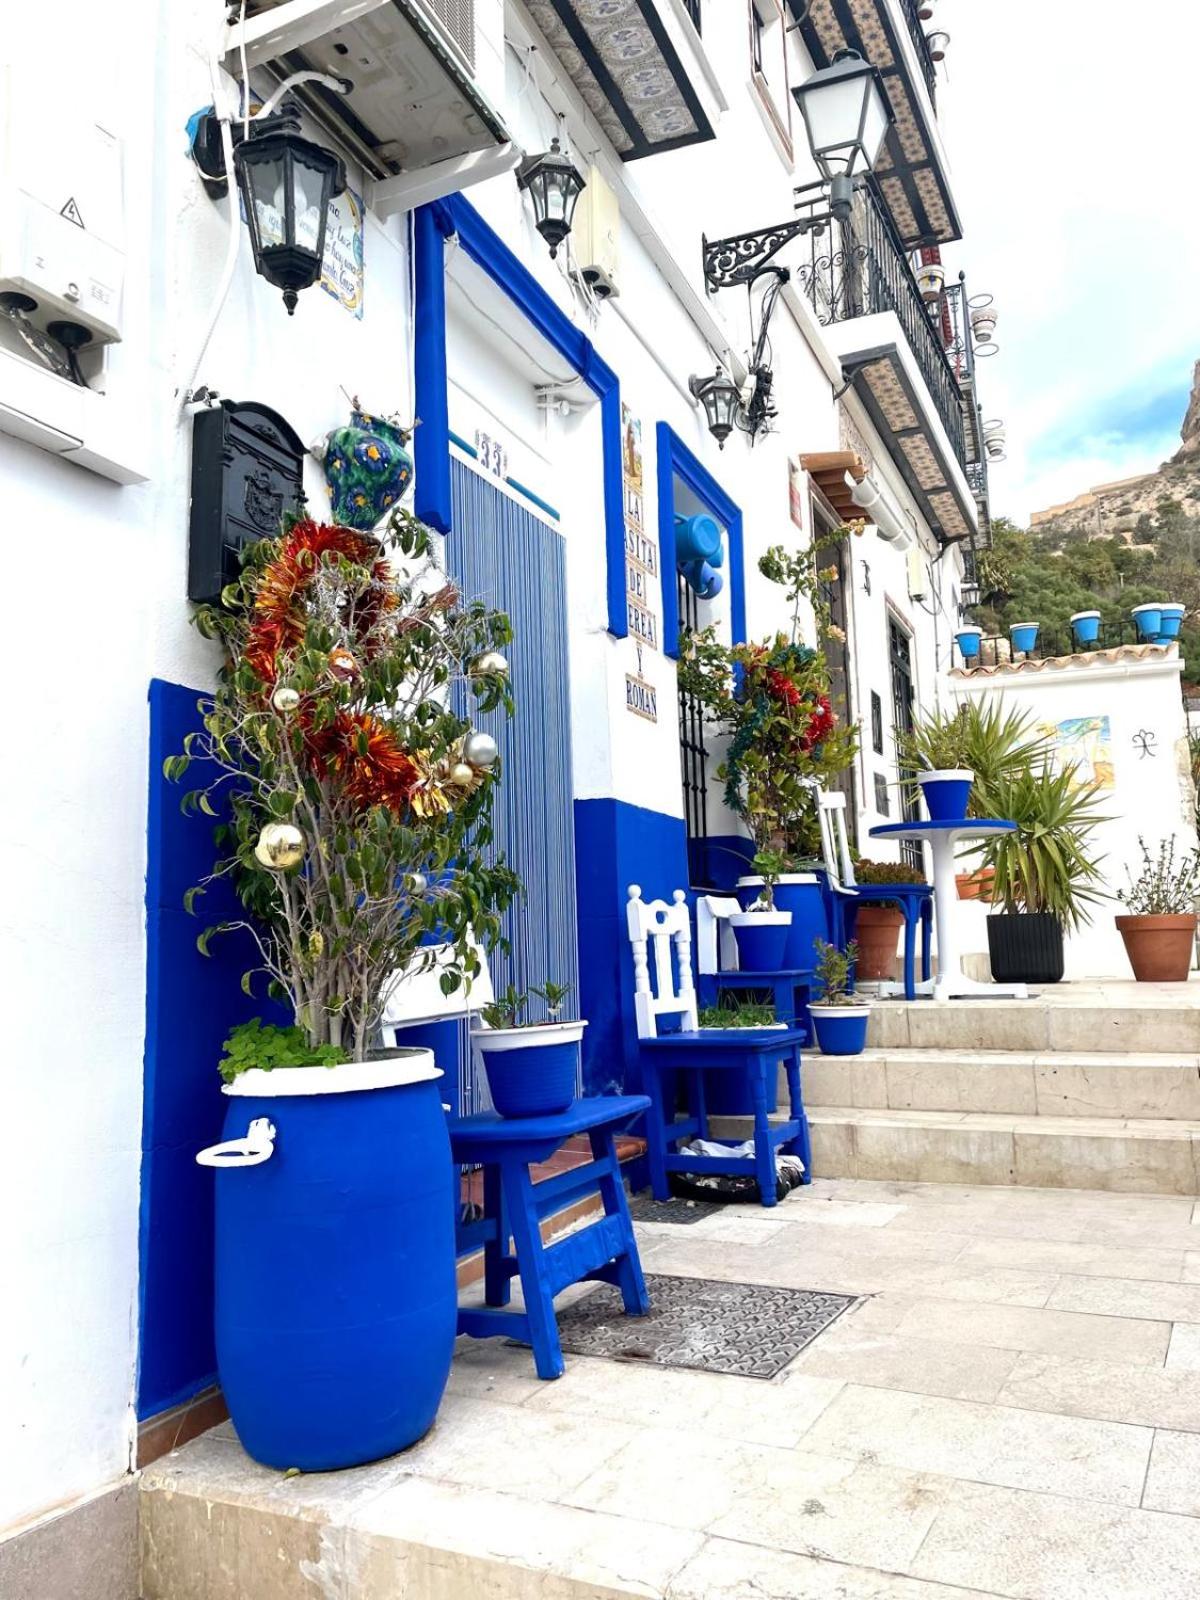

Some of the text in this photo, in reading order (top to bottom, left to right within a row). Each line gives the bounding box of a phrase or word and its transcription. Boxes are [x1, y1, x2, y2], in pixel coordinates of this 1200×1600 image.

[480, 440, 502, 478] 33
[628, 490, 640, 522] LA
[625, 529, 654, 570] SITA
[630, 567, 642, 598] DE
[628, 604, 654, 642] EREA
